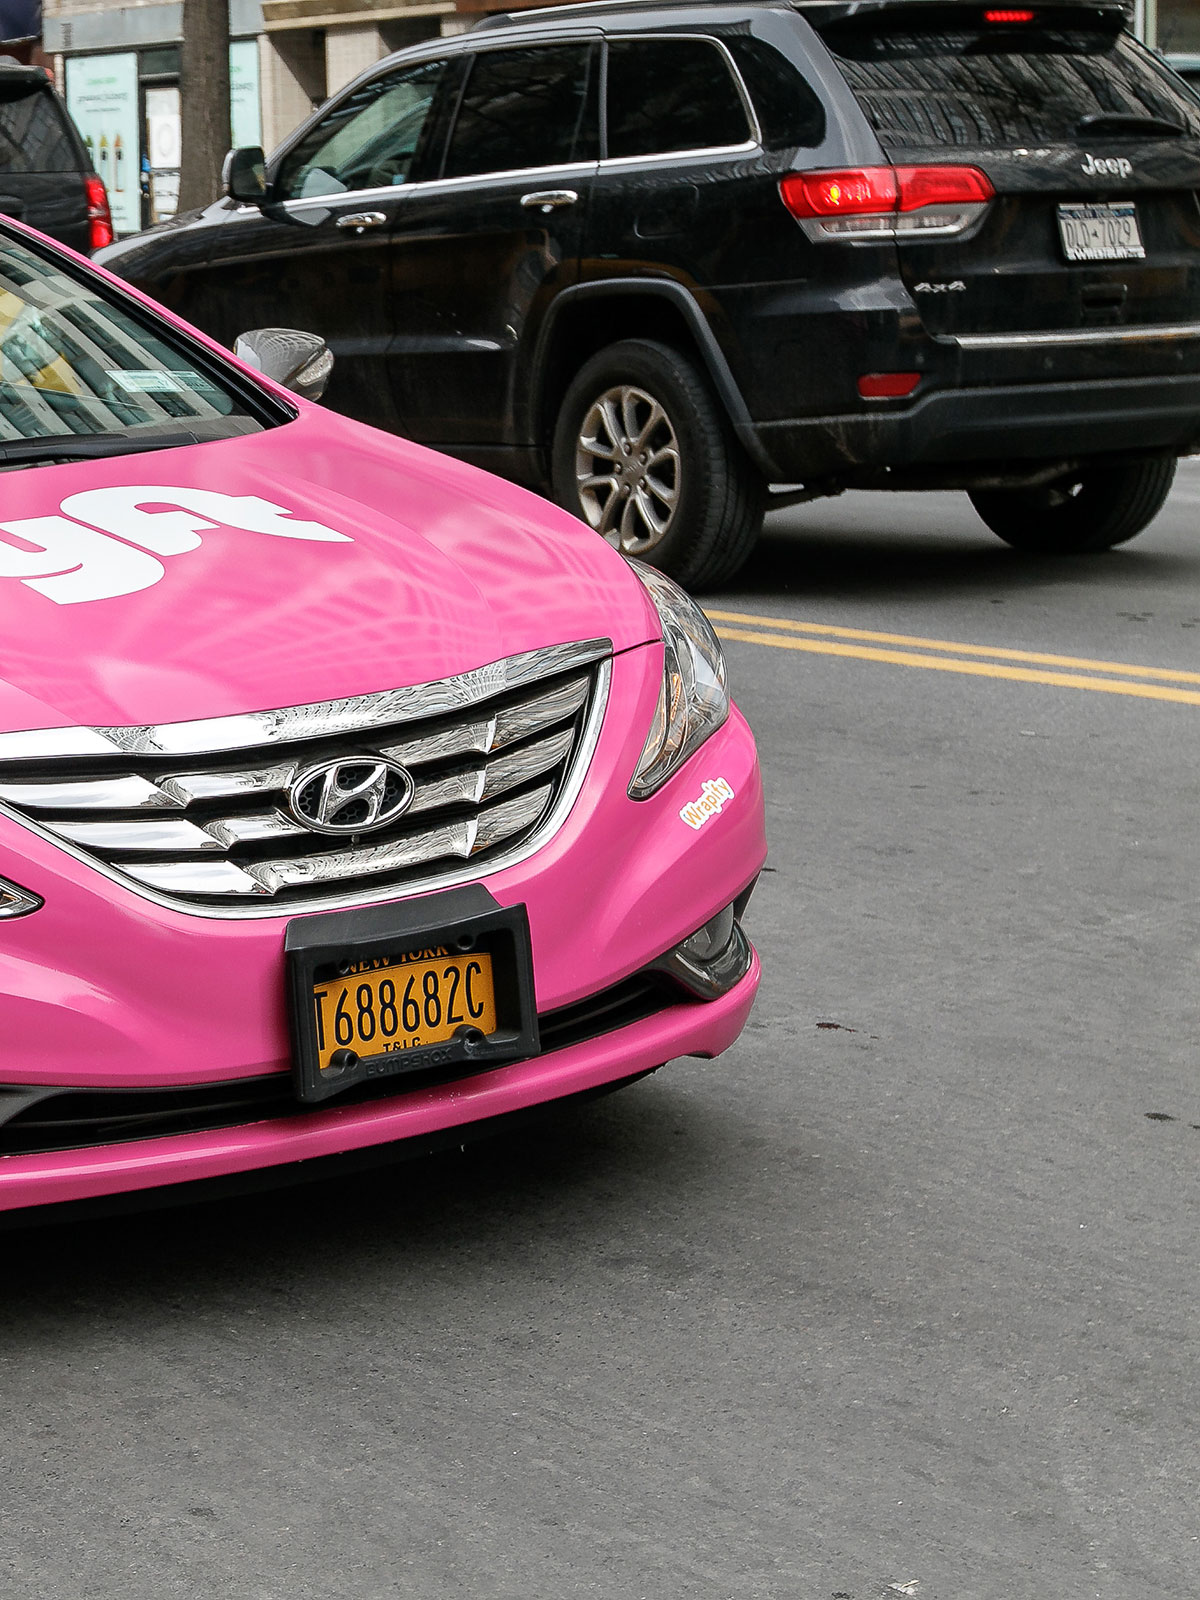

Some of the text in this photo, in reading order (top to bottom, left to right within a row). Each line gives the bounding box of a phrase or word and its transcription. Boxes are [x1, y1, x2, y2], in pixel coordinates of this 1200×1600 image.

[1080, 153, 1133, 178] Jeep
[682, 780, 732, 826] Wrapify
[313, 960, 485, 1052] T688682C
